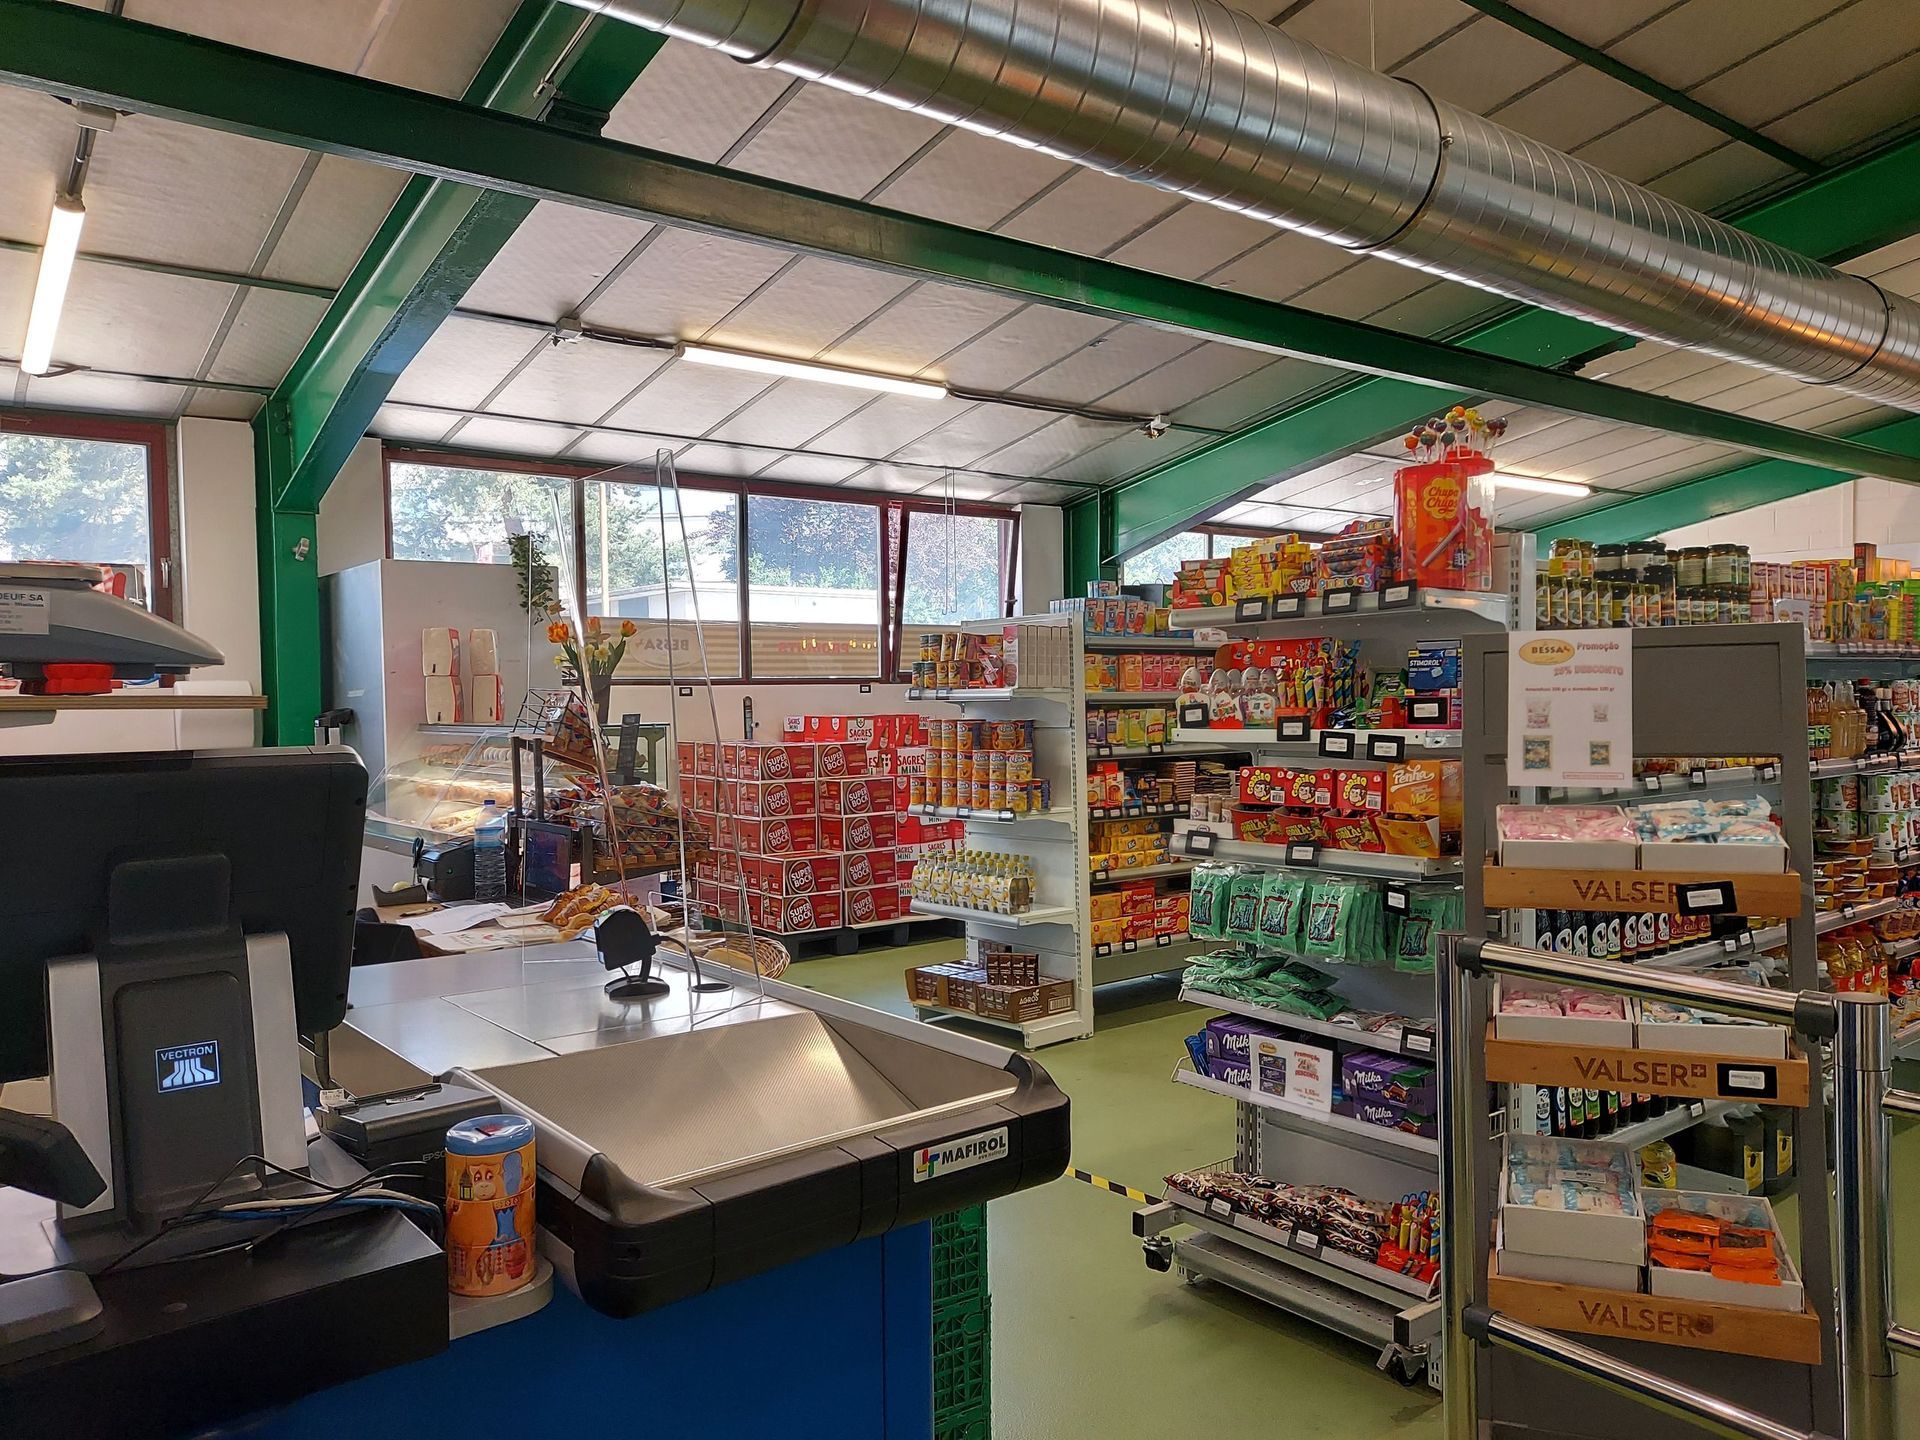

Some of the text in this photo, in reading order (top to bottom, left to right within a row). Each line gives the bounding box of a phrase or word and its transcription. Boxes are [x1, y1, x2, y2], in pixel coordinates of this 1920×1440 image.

[29, 593, 44, 602] SA
[1531, 646, 1564, 655] BESSA
[1577, 642, 1620, 652] Promoção
[1409, 659, 1440, 667] STIMOROL
[849, 728, 872, 738] SAGRES
[767, 753, 788, 768] SUPER
[824, 752, 844, 766] SUPER
[827, 758, 845, 772] BOCK
[897, 754, 925, 766] SAGRES
[770, 760, 789, 773] BOCK
[901, 766, 921, 774] MINI
[767, 790, 788, 803] SUPER
[848, 787, 868, 800] SUPER
[770, 796, 789, 810] BOCK
[851, 794, 870, 807] BOCK
[767, 826, 788, 840] SUPER
[850, 824, 870, 837] SUPER
[852, 830, 871, 844] BOCK
[770, 833, 790, 846] BOCK
[895, 845, 914, 854] SAGRES
[927, 842, 946, 852] SAGRES
[897, 852, 911, 861] MINI
[849, 860, 869, 874] SUPER
[852, 867, 870, 880] BOCK
[791, 867, 812, 881] SUPER
[794, 874, 814, 887] BOCK
[852, 896, 872, 911] SUPER
[1132, 893, 1152, 902] Digestive
[789, 903, 811, 917] SUPER
[855, 903, 874, 917] BOCK
[792, 910, 813, 924] BOCK
[1133, 919, 1152, 927] Digestive
[1223, 1033, 1250, 1051] Milk
[160, 1044, 214, 1061] VECTRON
[1224, 1067, 1251, 1085] Milk
[1354, 1070, 1383, 1086] Milka
[1573, 1056, 1690, 1088] VALSER
[1364, 1105, 1393, 1120] Milka
[422, 1150, 446, 1162] EPSO
[942, 1135, 1006, 1165] MAFIROL
[1578, 1300, 1697, 1338] VALSER
